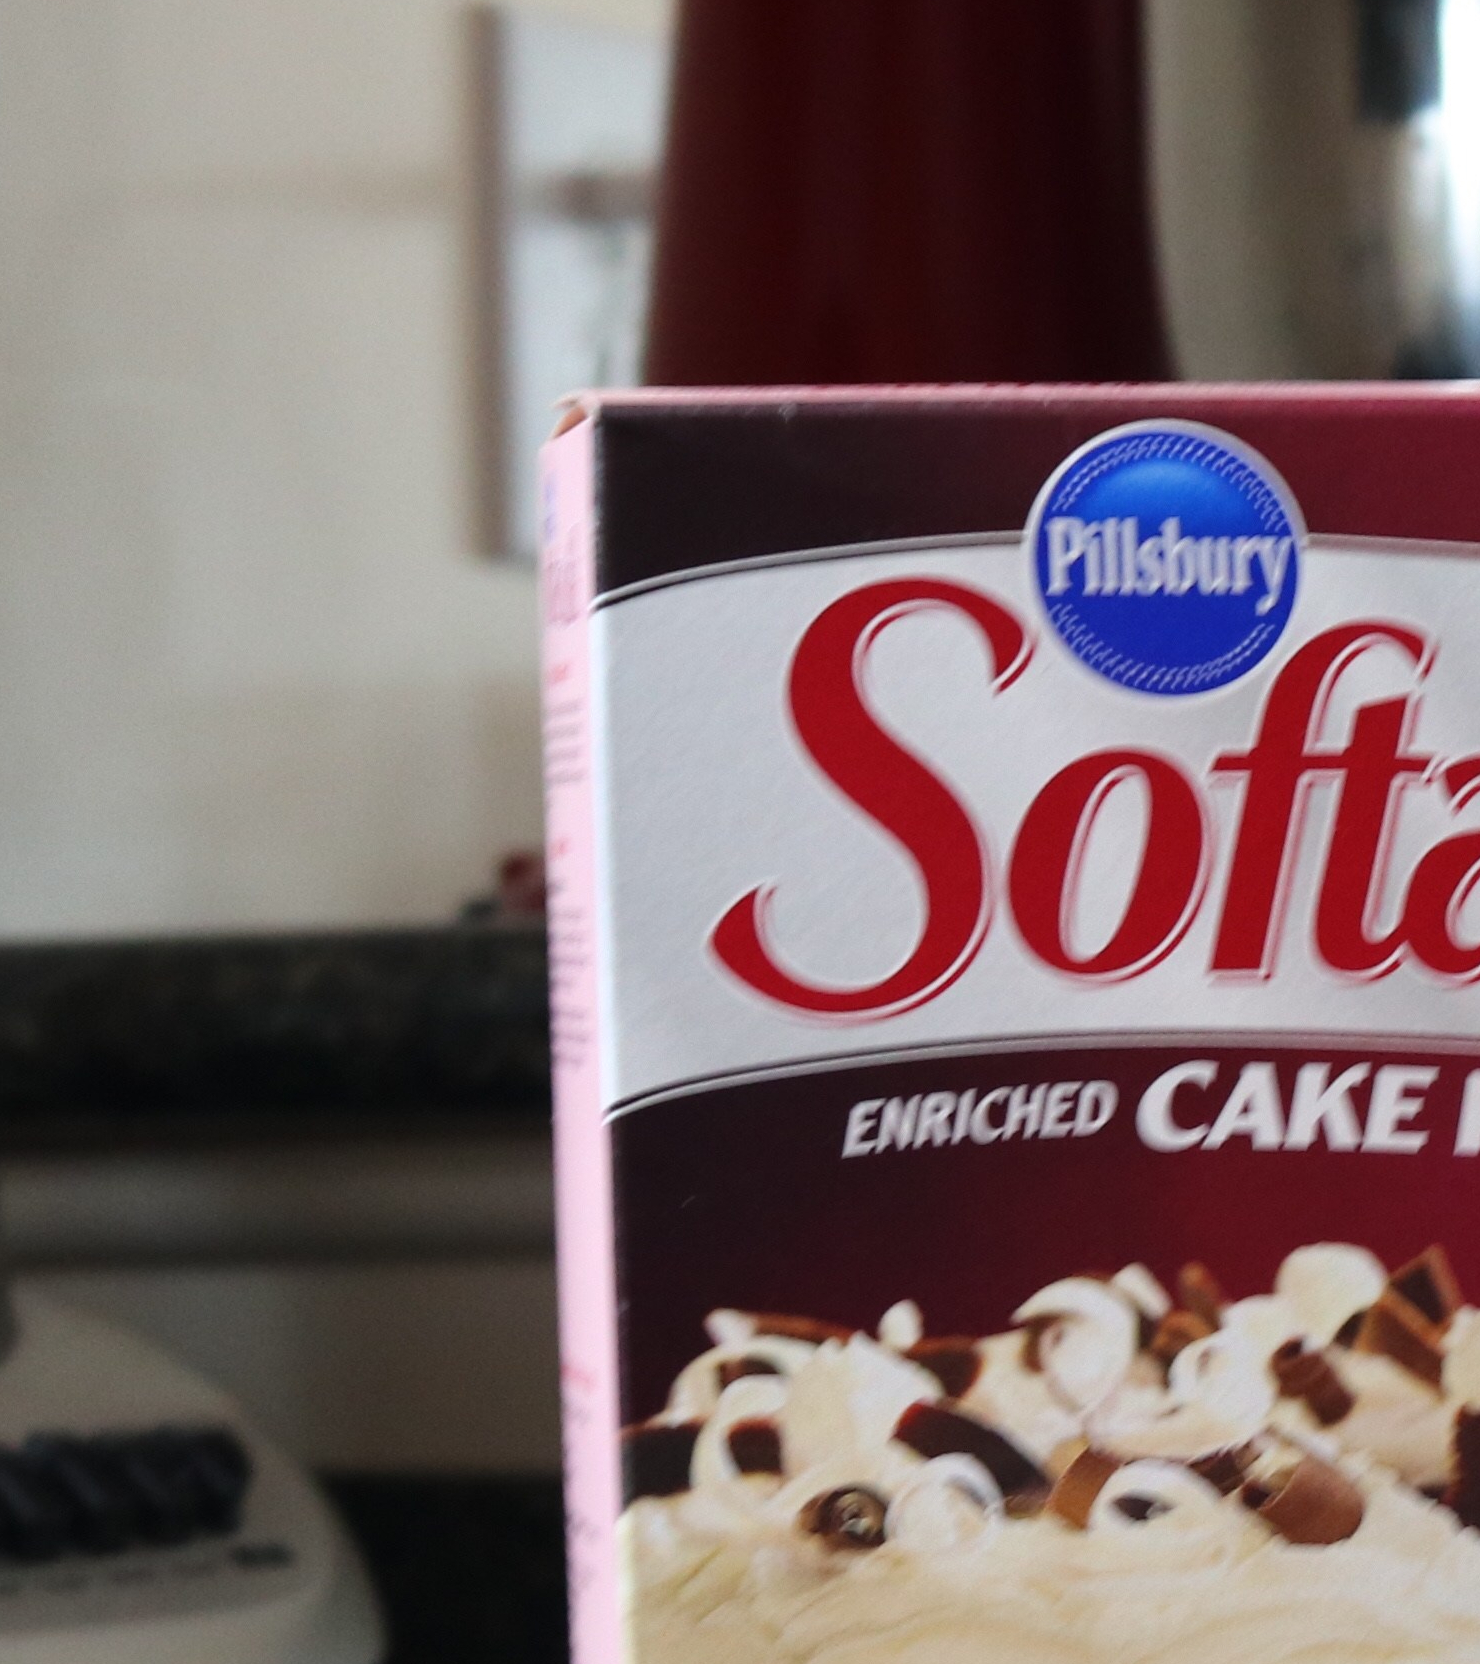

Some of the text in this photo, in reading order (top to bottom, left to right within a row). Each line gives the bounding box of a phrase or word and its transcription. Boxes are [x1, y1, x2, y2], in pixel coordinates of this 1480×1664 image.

[1046, 515, 1292, 615] Pillsbury
[840, 1080, 1120, 1160] ENRICHED
[1136, 1058, 1440, 1156] CAKE
